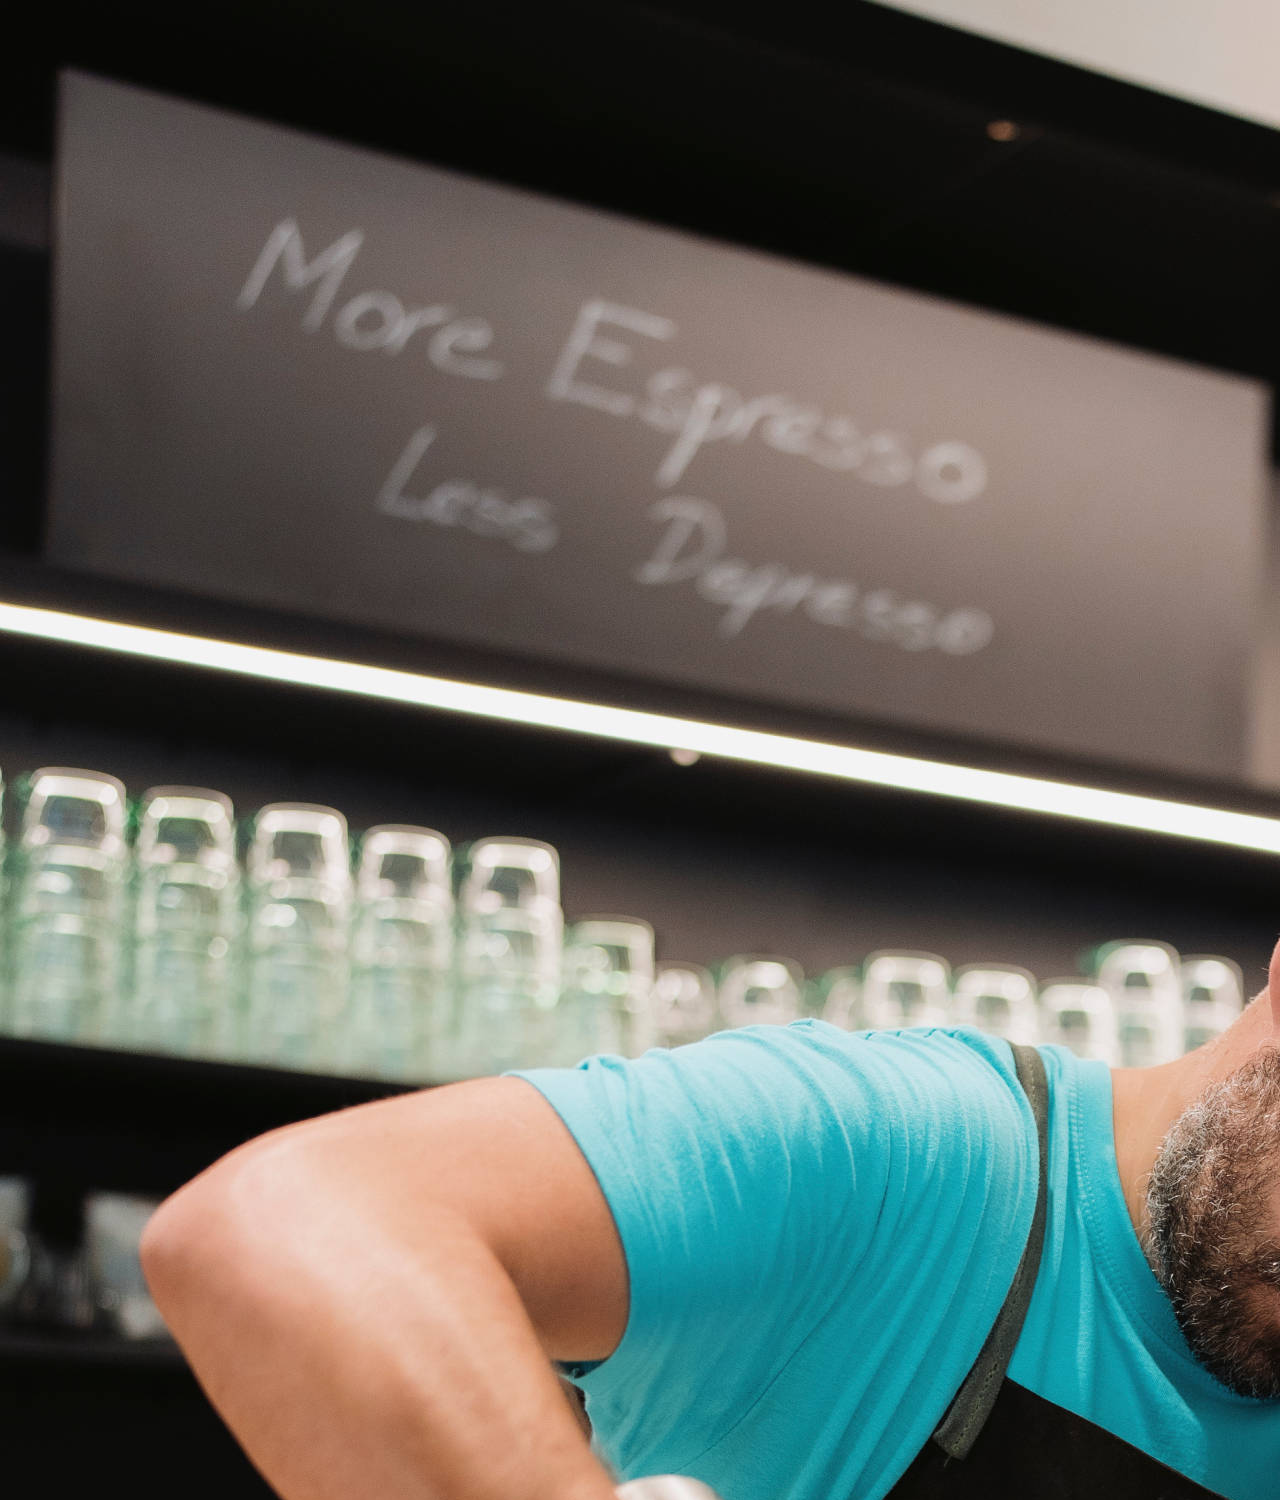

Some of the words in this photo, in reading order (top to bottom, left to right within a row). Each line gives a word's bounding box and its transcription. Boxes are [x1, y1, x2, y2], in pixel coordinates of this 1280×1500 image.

[238, 217, 504, 380] More
[549, 301, 988, 504] Espresso
[378, 427, 560, 553] Less
[638, 495, 996, 656] Depresso
